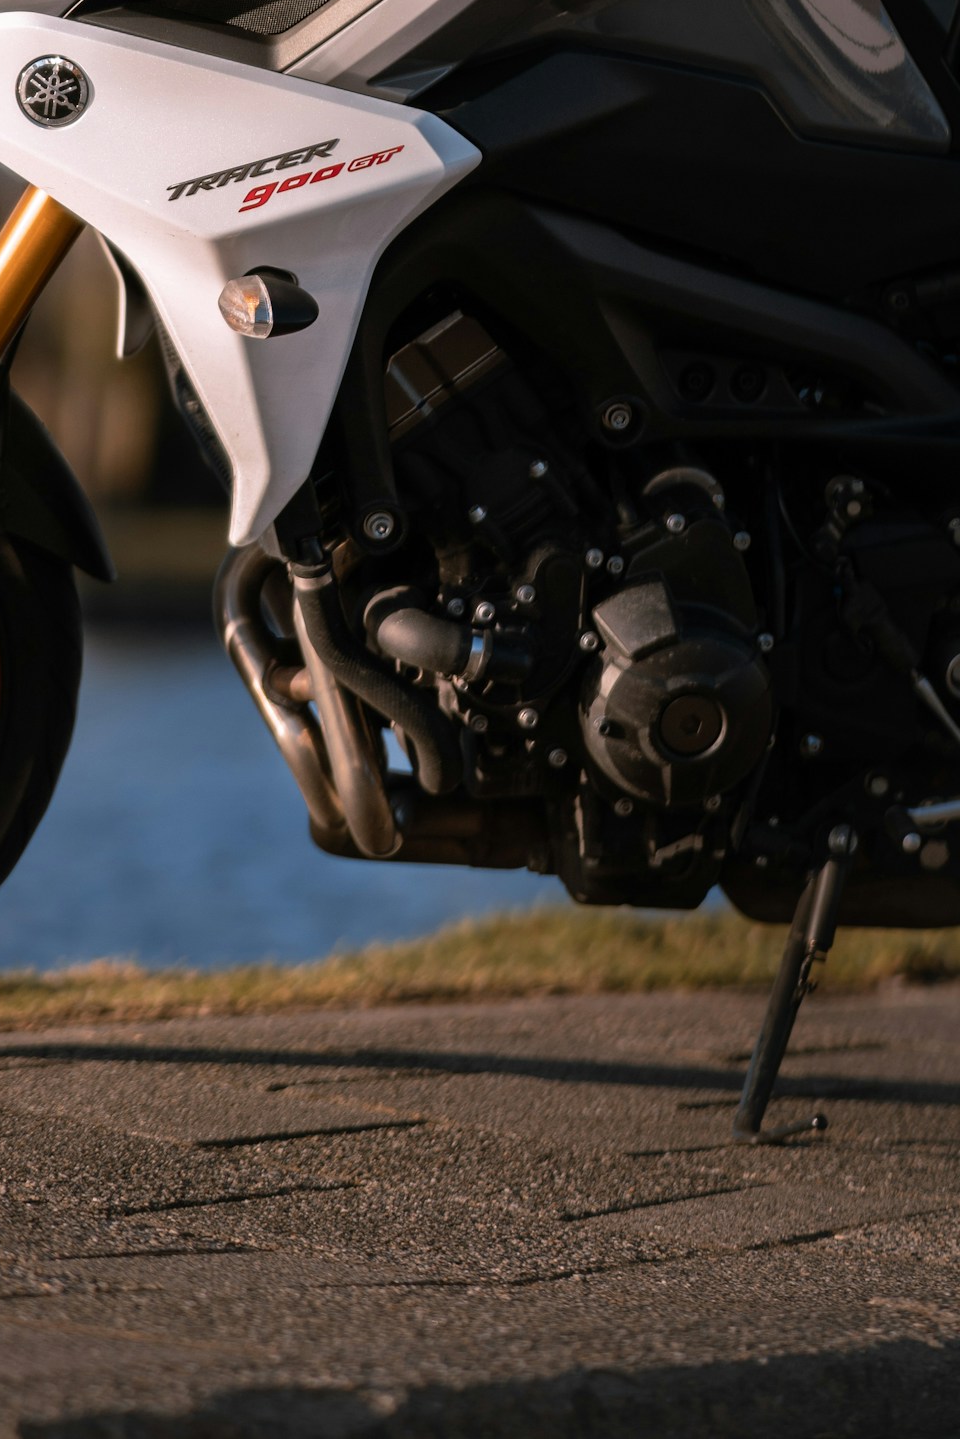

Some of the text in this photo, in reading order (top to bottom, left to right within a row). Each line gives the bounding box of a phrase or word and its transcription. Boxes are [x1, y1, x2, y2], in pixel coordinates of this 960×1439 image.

[166, 137, 340, 201] TRACER
[238, 144, 405, 213] 900 GT
